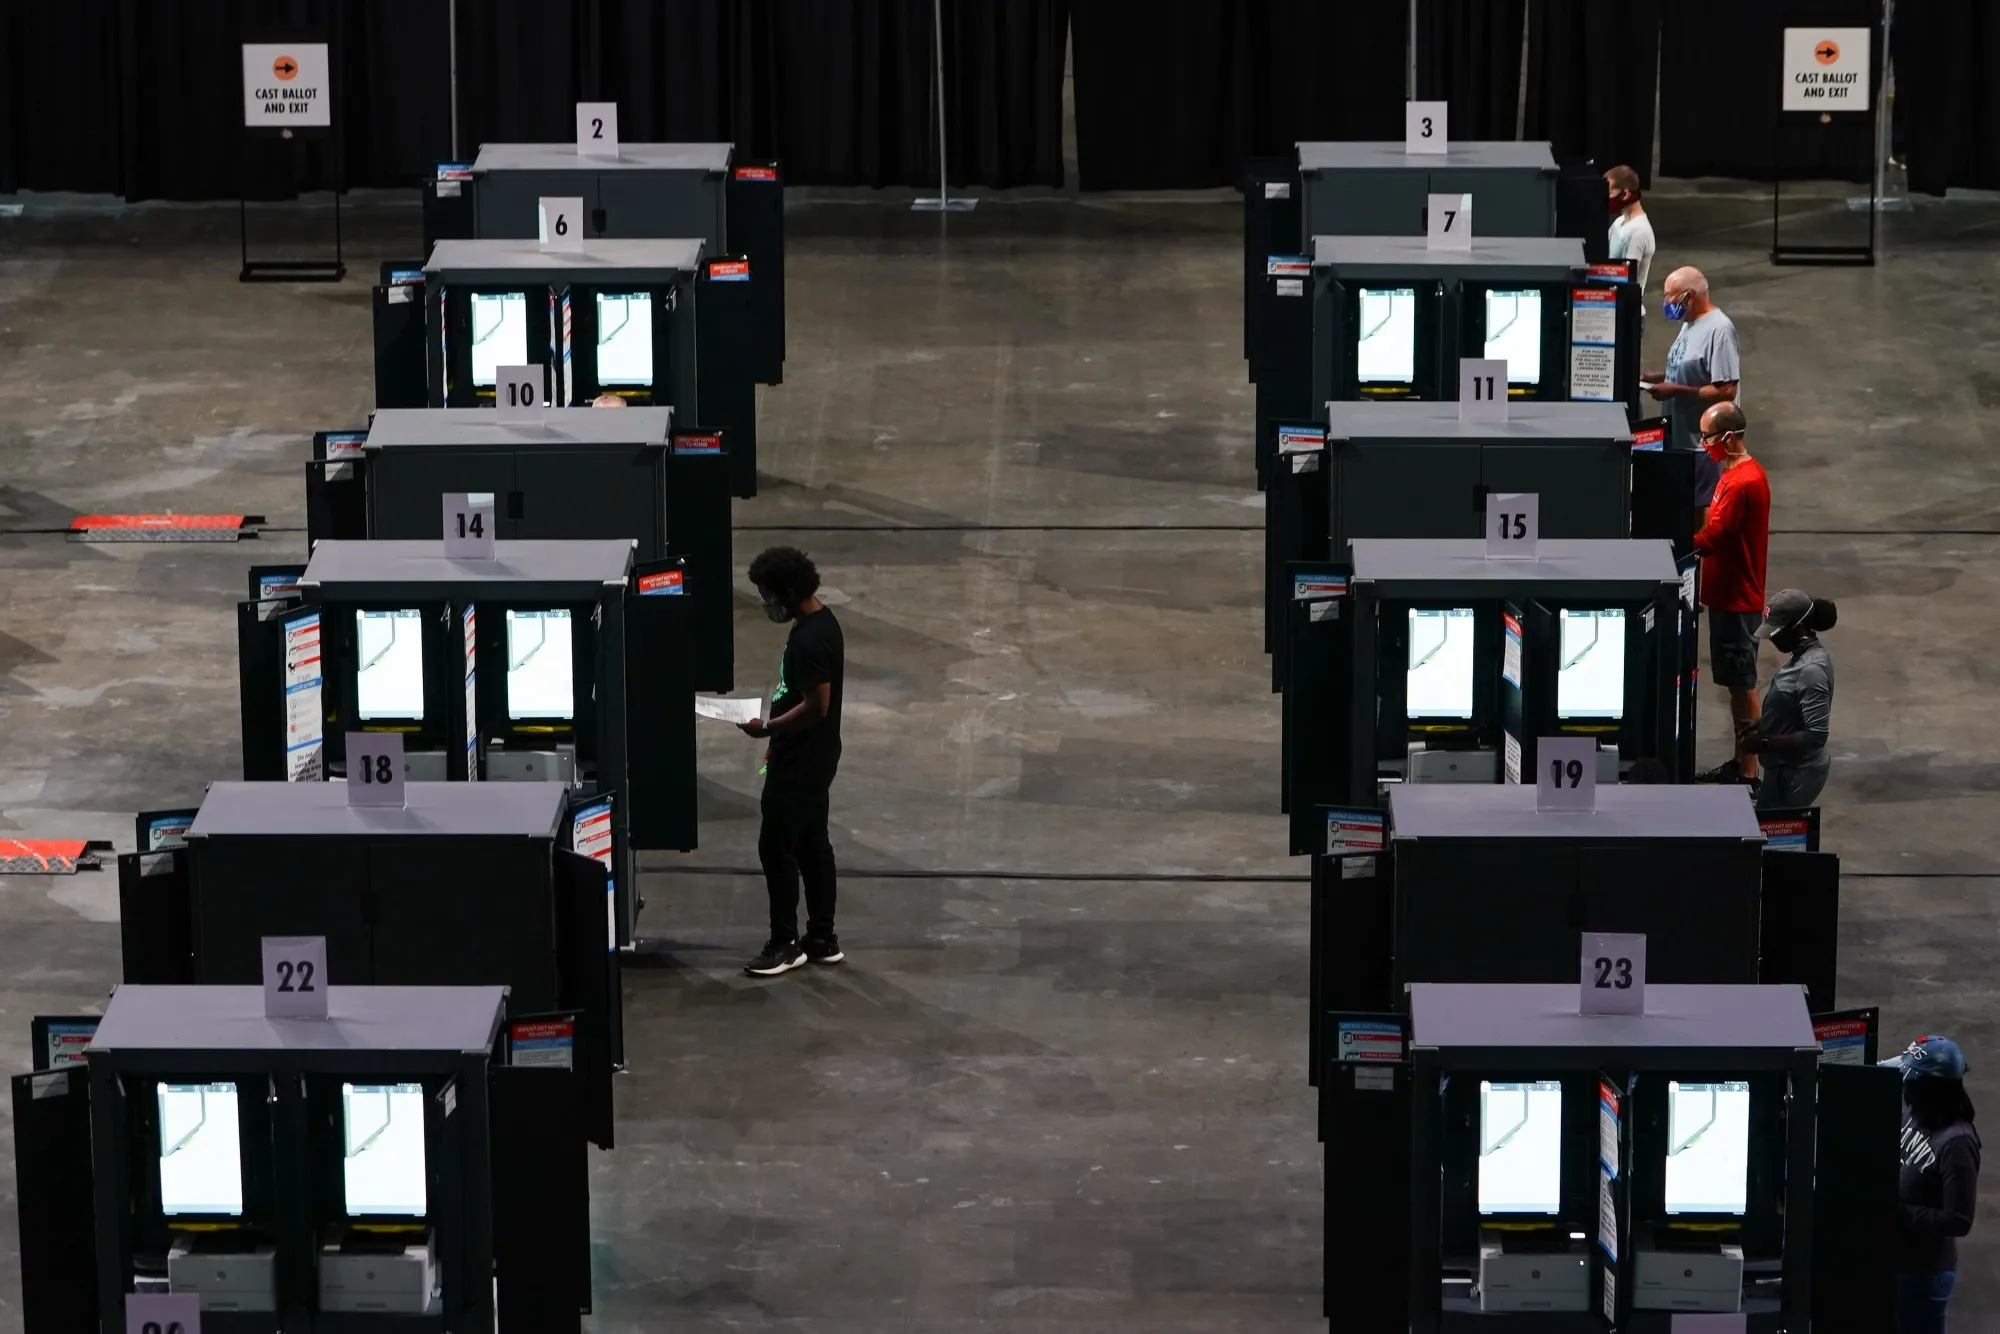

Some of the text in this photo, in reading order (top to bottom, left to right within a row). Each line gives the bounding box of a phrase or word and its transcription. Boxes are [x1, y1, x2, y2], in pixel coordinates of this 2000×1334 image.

[1796, 73, 1858, 84] CAST BALLOT
[255, 88, 317, 100] CAST BALLOT
[1804, 87, 1849, 98] AND EXIT
[264, 102, 309, 114] AND EXIT
[591, 118, 603, 139] 2
[1421, 117, 1433, 138] 3
[555, 214, 568, 236] 6
[1443, 211, 1457, 232] 7
[508, 382, 534, 407] 10
[1473, 377, 1494, 400] 11
[457, 513, 484, 538] 14
[1500, 514, 1526, 539] 15
[361, 755, 392, 784] 18
[1552, 760, 1583, 788] 19
[277, 961, 314, 992] 22
[1595, 957, 1632, 989] 23
[517, 1024, 547, 1033] IMPORTANT
[1815, 1025, 1840, 1033] MPORTANT
